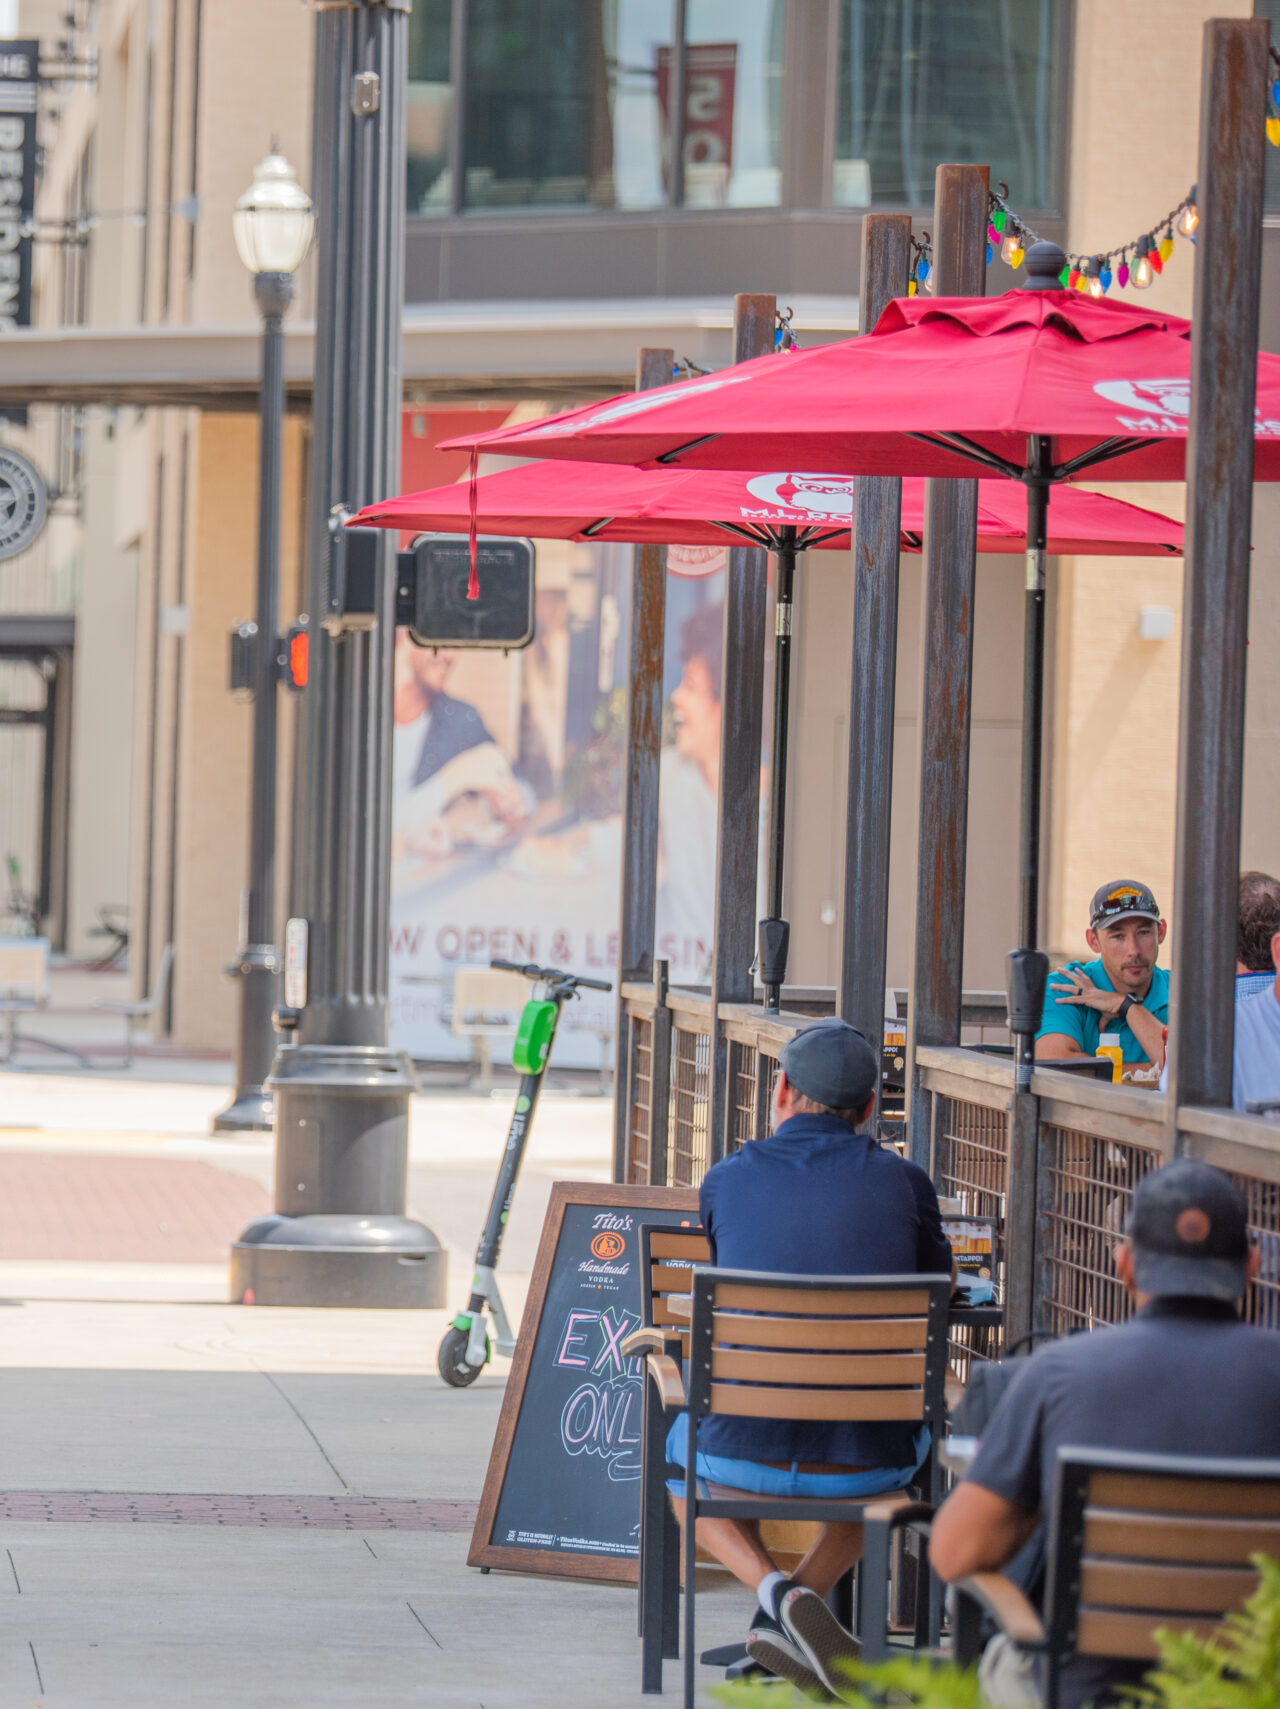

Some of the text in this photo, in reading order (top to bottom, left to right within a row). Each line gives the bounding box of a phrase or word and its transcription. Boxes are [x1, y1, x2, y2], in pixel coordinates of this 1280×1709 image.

[436, 924, 536, 962] OPEN
[550, 928, 571, 963] &
[577, 1259, 630, 1275] Handmade
[588, 1275, 614, 1284] VODKA
